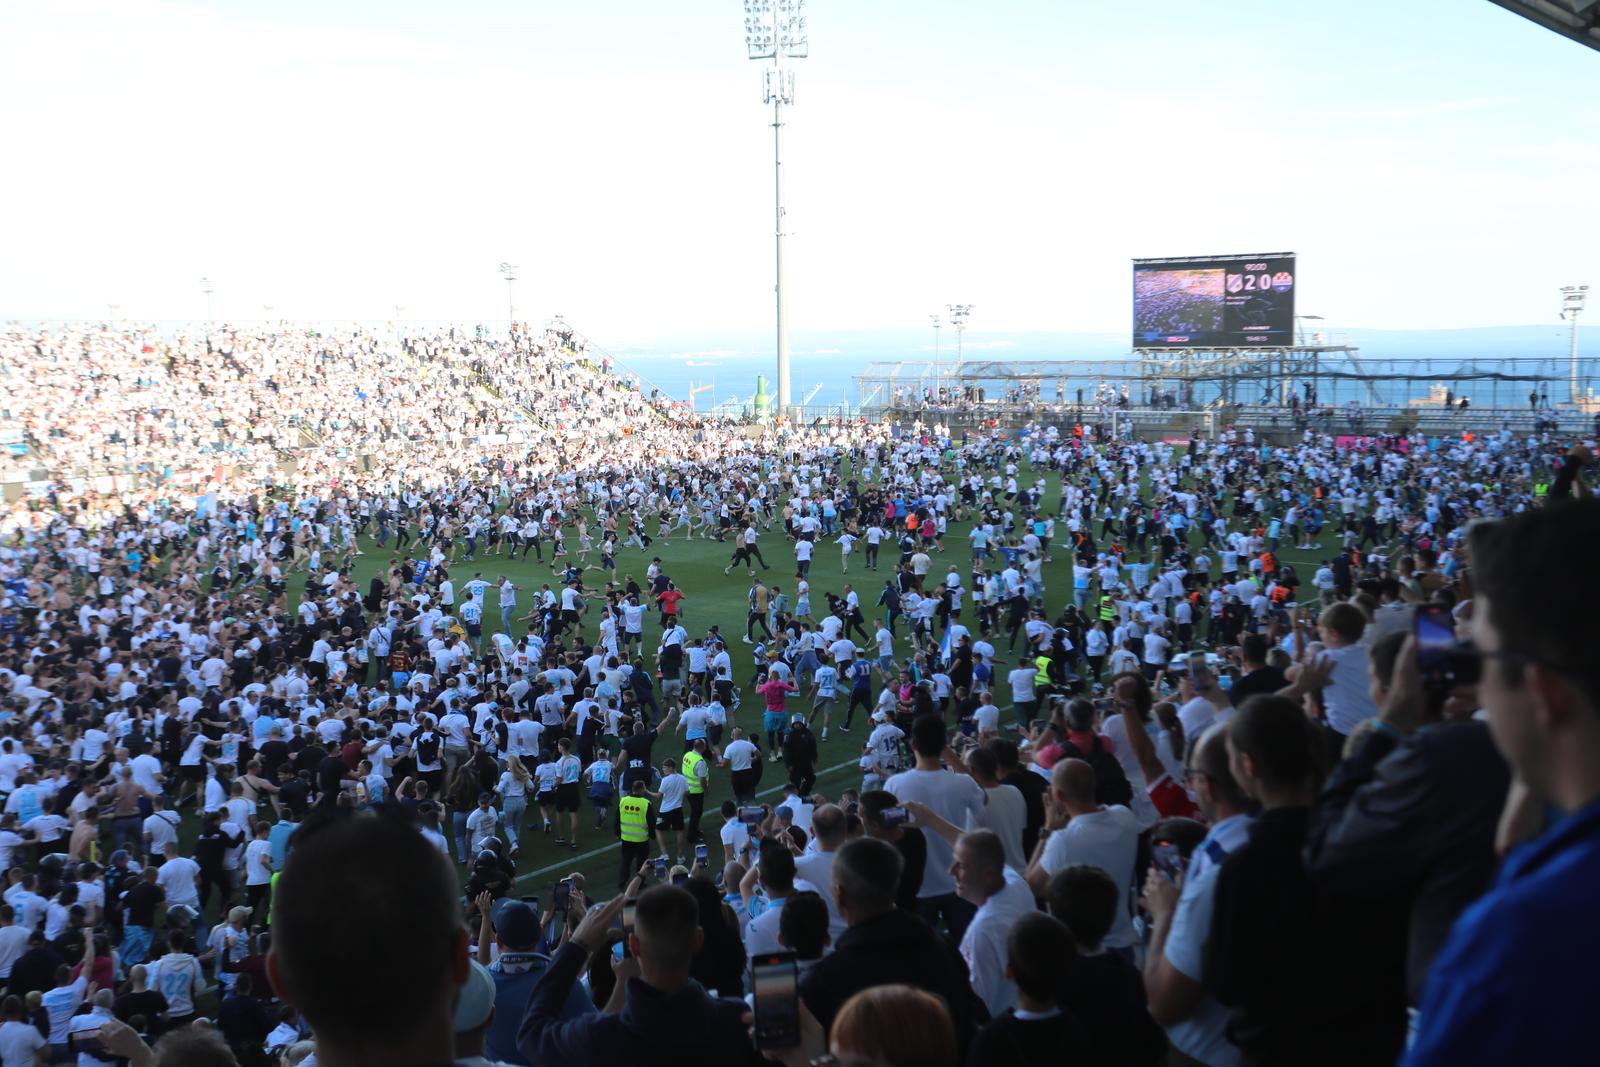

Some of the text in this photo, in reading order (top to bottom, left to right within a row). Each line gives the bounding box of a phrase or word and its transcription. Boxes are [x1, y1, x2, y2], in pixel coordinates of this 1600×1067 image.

[1244, 273, 1271, 290] 2 0
[1009, 552, 1016, 561] 2
[860, 663, 870, 675] 11
[883, 735, 896, 752] 15
[164, 972, 188, 996] 22
